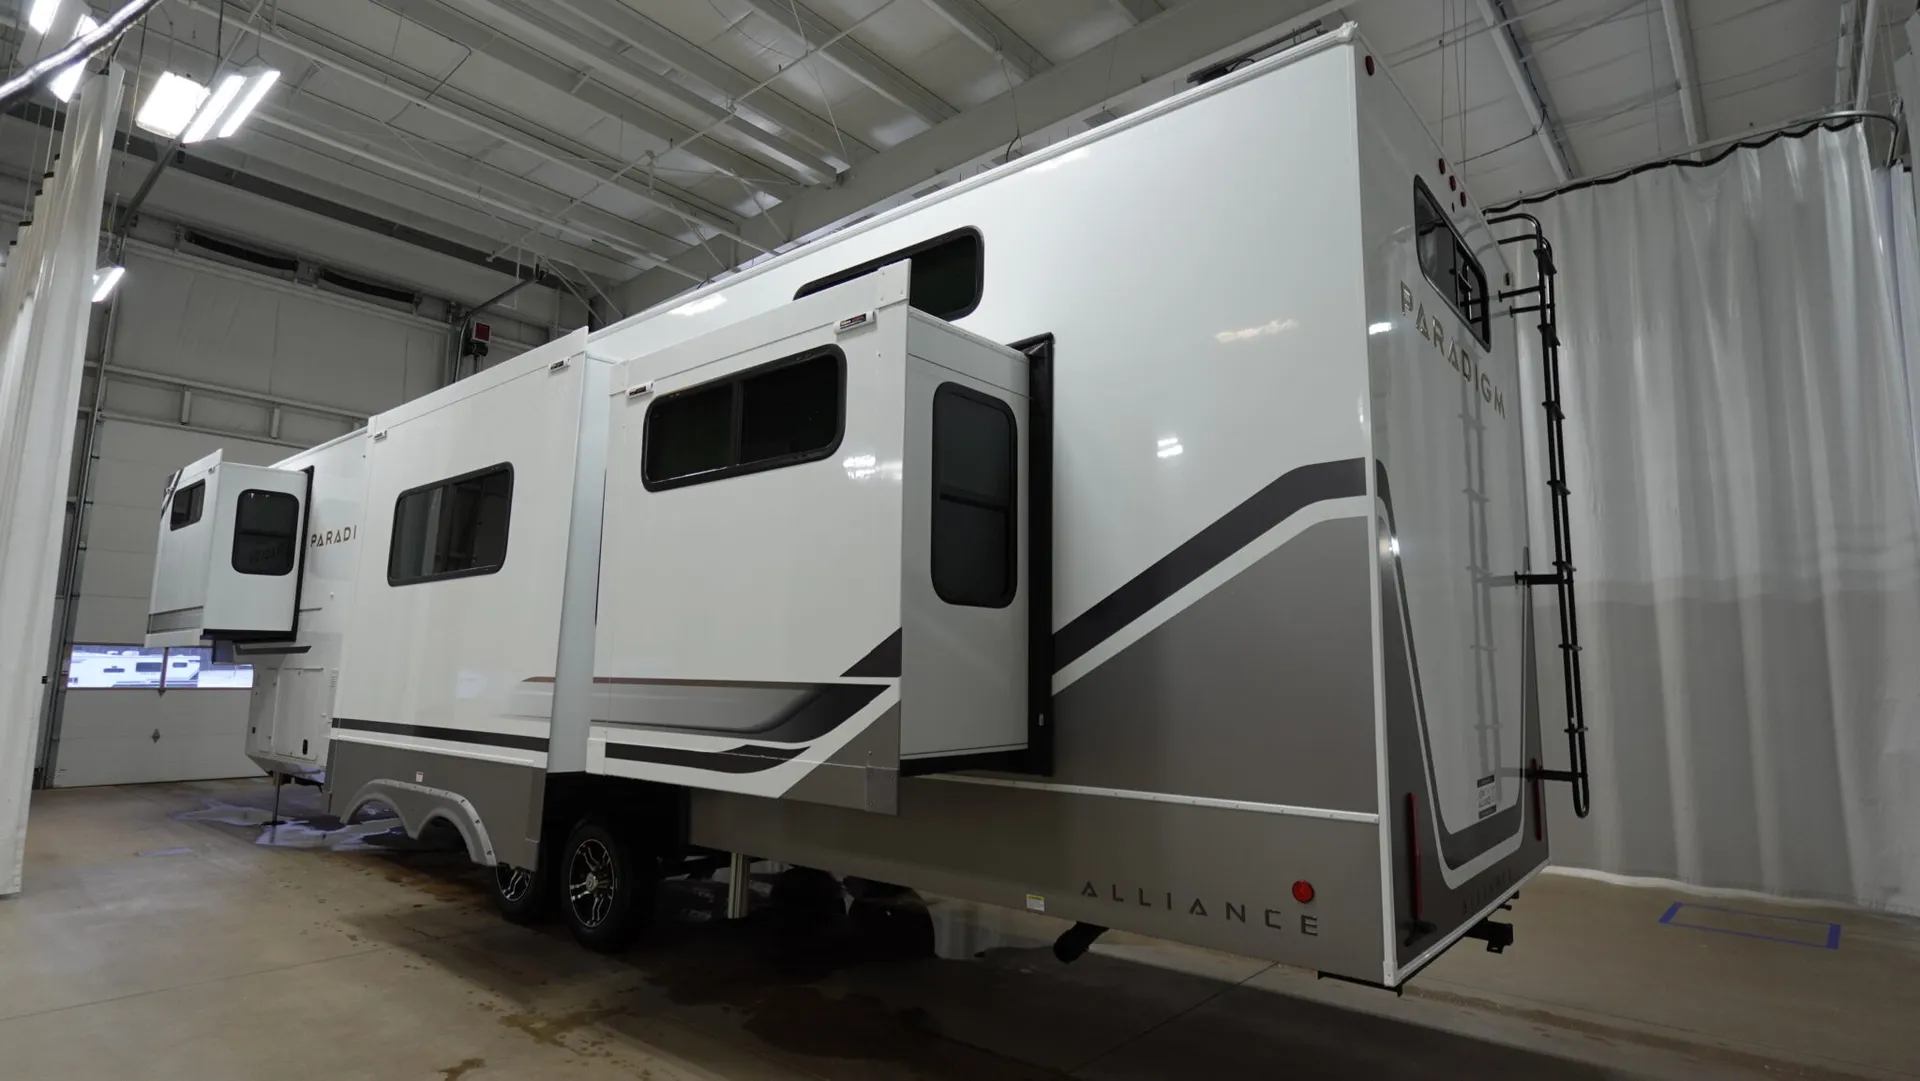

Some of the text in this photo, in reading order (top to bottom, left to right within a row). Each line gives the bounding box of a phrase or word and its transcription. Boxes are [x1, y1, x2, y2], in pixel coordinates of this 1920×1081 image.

[1401, 280, 1505, 420] PARADIGM
[310, 525, 357, 548] PARADI
[1081, 881, 1318, 937] ALLIANCE
